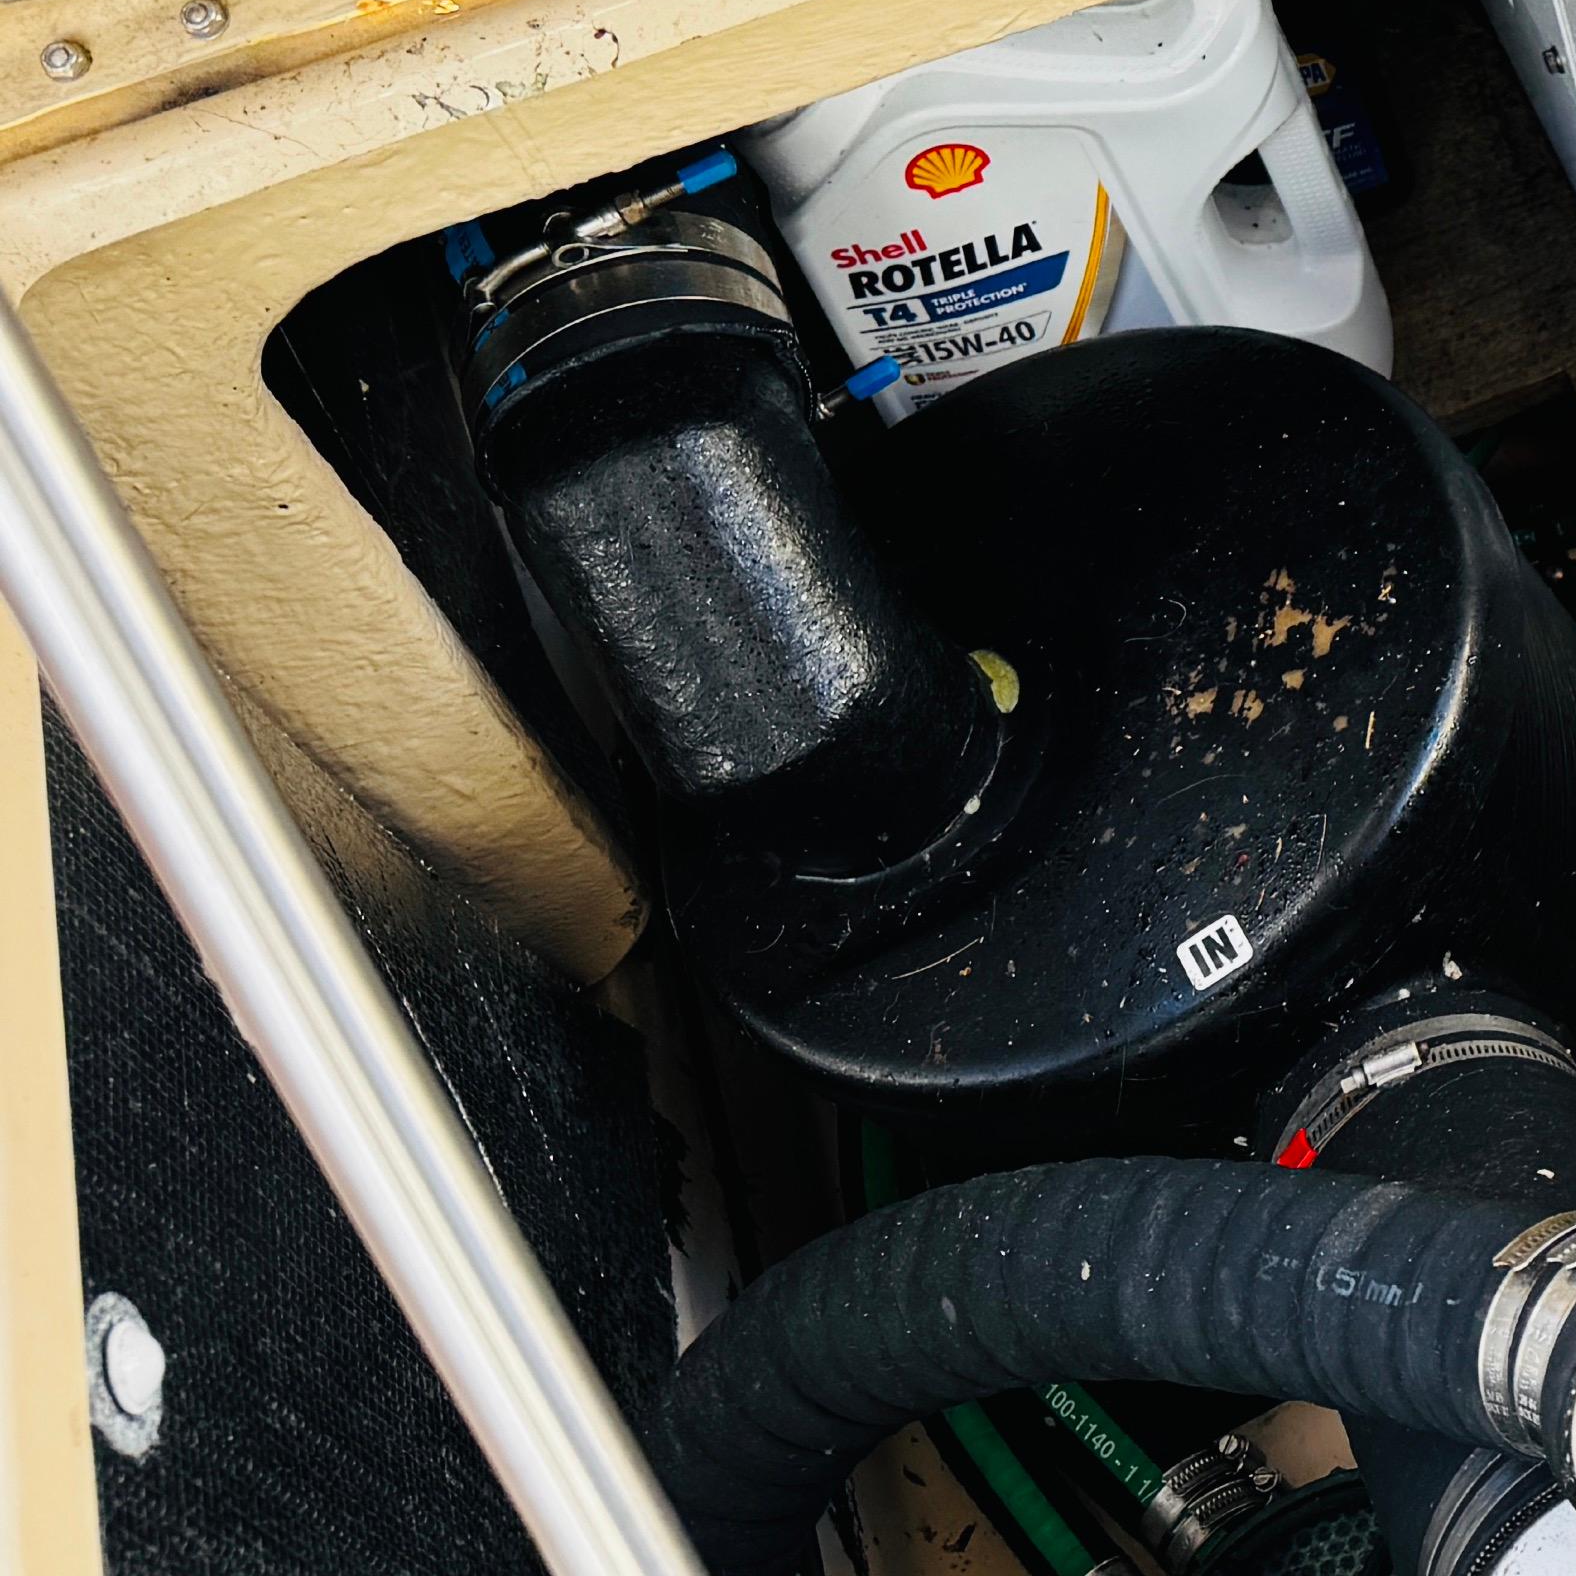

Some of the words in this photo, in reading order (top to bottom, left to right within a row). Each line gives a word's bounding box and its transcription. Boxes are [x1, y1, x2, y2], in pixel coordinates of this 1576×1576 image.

[830, 228, 928, 269] Shell
[848, 222, 1043, 300] ROTELLA
[863, 301, 919, 328] T4
[930, 288, 977, 308] TRIPLE
[936, 283, 1025, 316] PROTECTION
[919, 320, 1037, 363] 15W-40
[1188, 926, 1239, 978] IN
